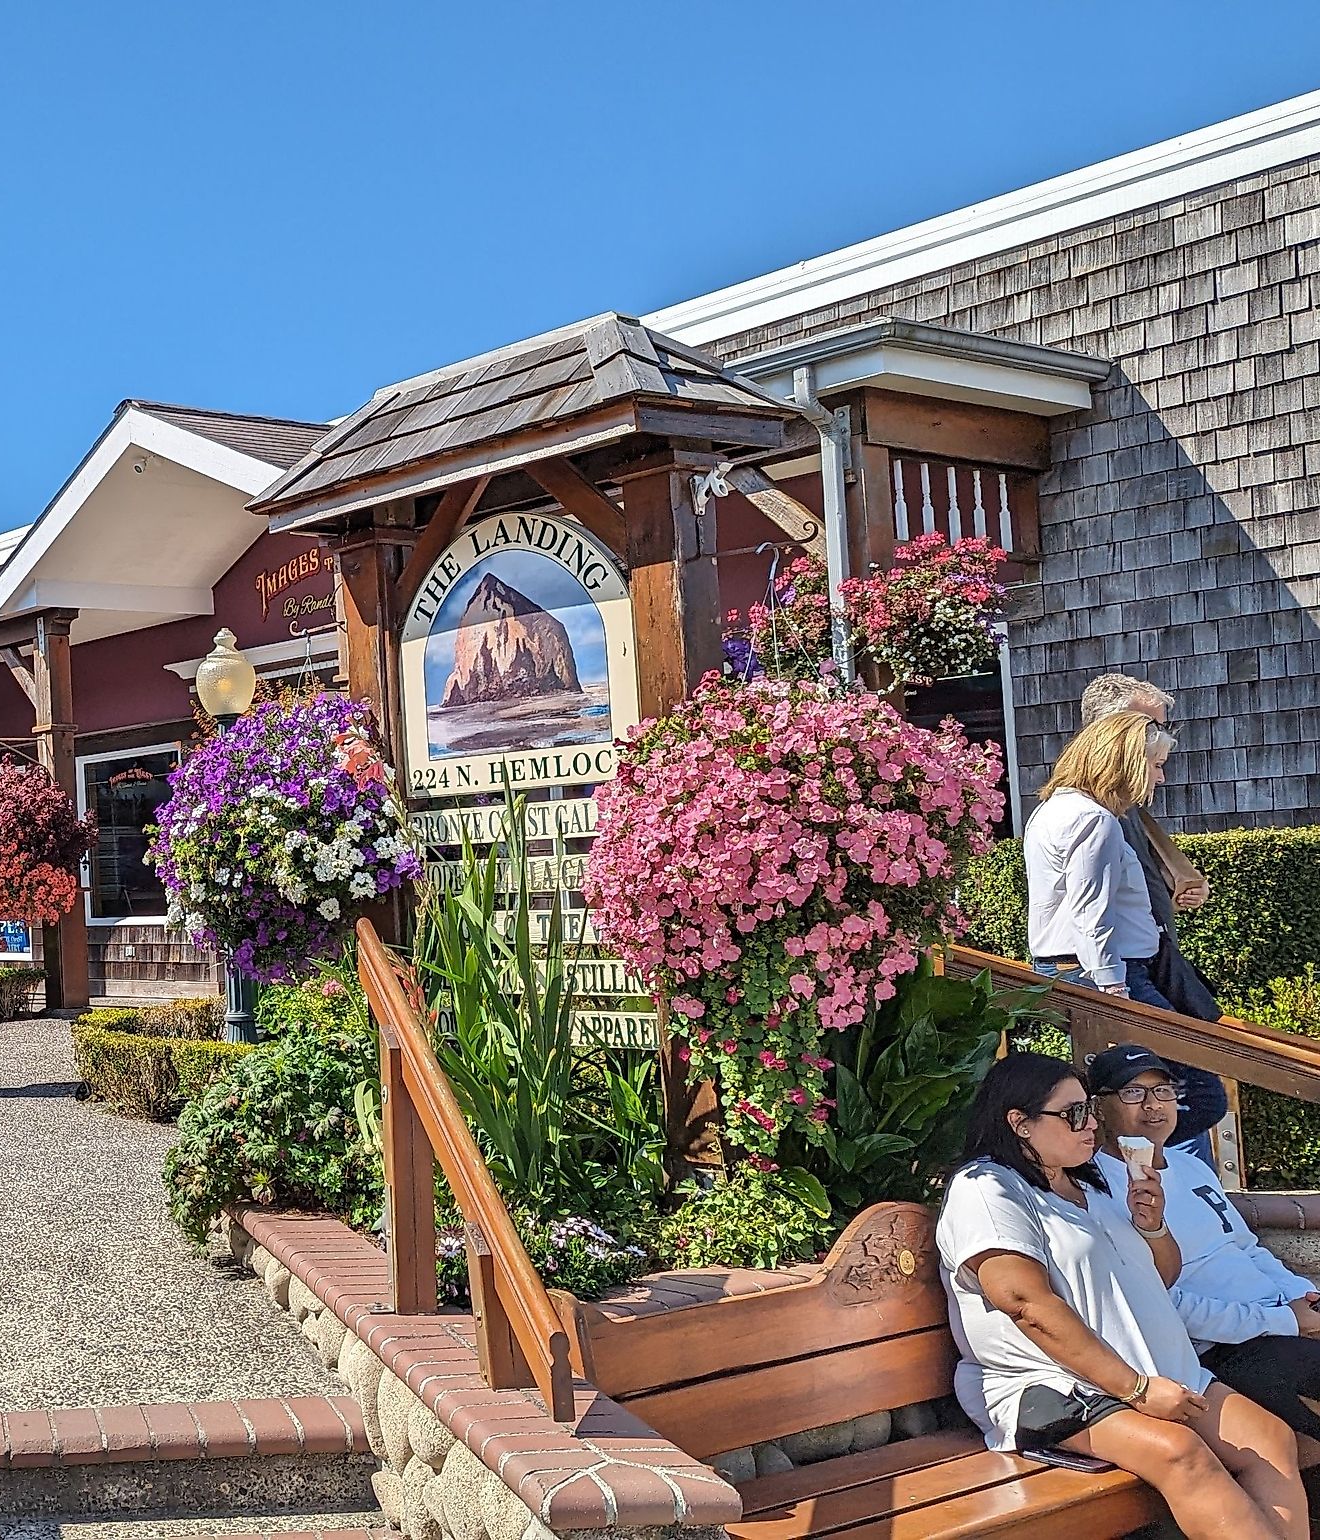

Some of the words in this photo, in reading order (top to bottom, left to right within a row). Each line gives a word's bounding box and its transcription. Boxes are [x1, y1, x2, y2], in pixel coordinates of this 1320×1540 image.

[255, 548, 319, 618] IMAGES
[414, 552, 462, 623] THE
[468, 516, 609, 591] LANDING
[284, 597, 300, 618] By
[414, 767, 450, 791] 224
[456, 764, 479, 787] N.
[488, 749, 618, 784] HEMLOC
[1192, 1185, 1234, 1234] P
